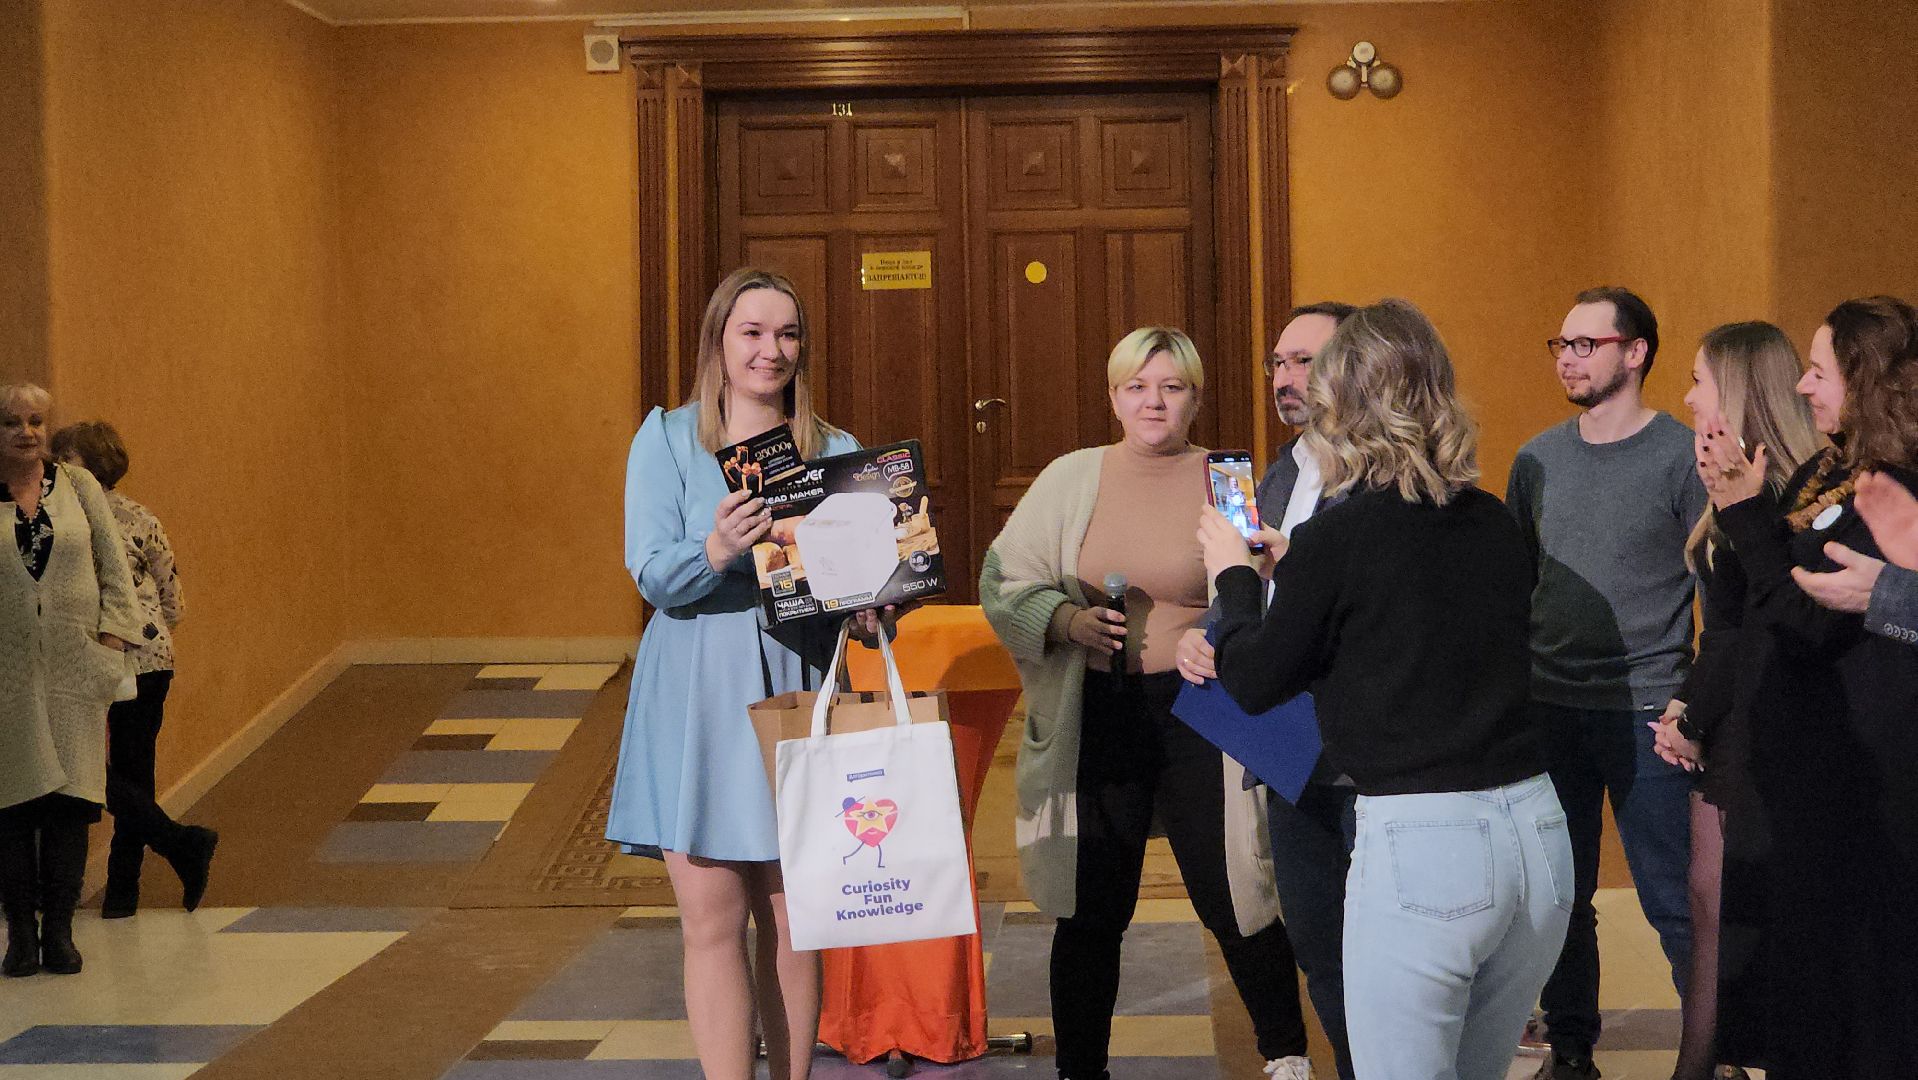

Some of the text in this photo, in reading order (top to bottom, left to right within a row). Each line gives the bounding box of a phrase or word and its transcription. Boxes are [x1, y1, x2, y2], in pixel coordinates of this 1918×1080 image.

[832, 103, 853, 117] 131
[876, 452, 912, 464] CLASSIC
[765, 494, 788, 505] EAD
[789, 487, 825, 501] MAKER
[902, 577, 938, 592] 550 W
[776, 598, 805, 609] ЧАША
[824, 599, 839, 609] 19
[778, 606, 816, 618] ПОКРЫТИЕМ
[841, 878, 911, 896] Curiosity
[864, 893, 893, 905] Fun
[836, 901, 924, 921] Knowledge
